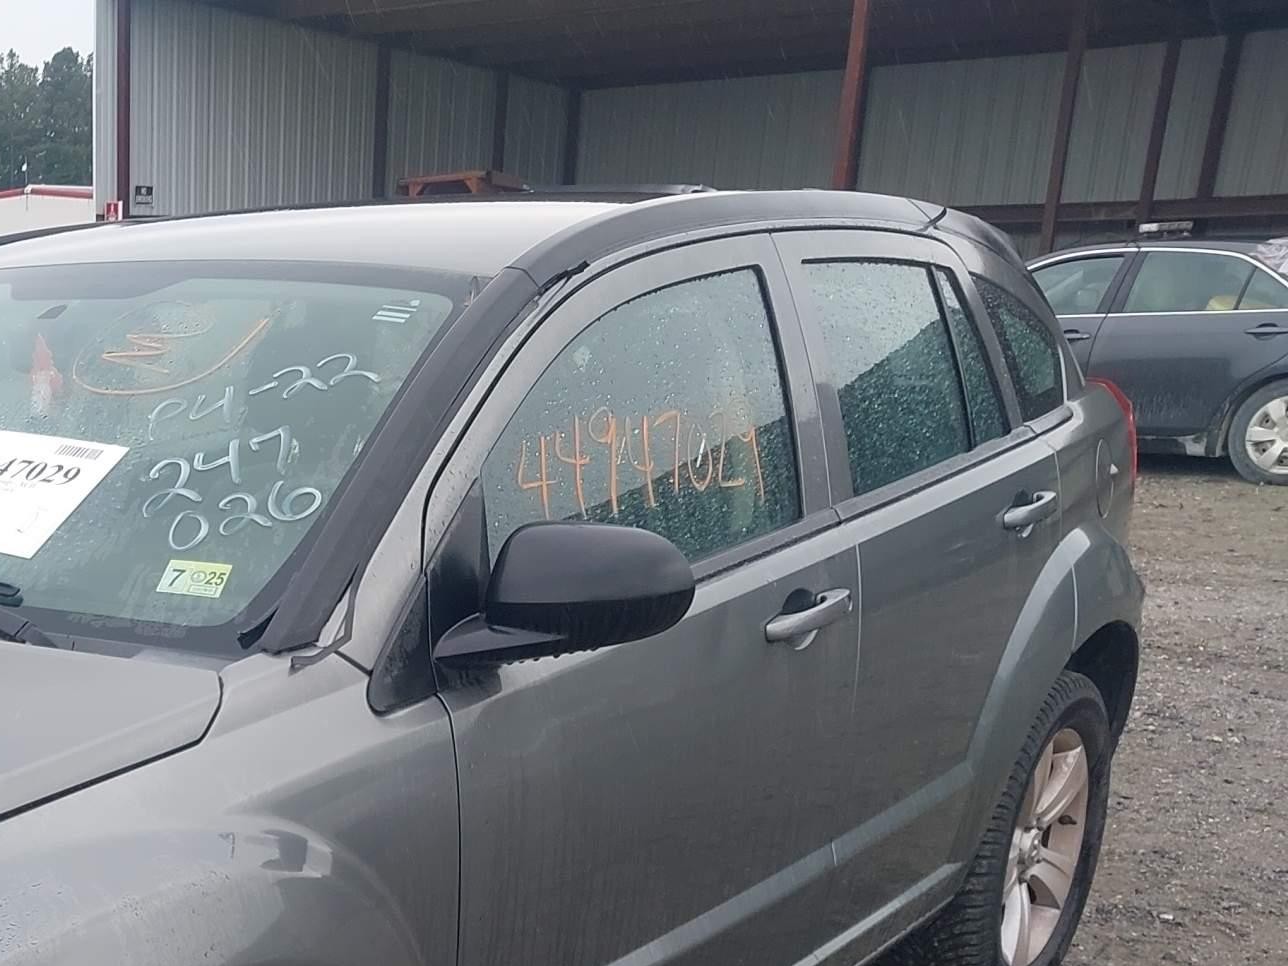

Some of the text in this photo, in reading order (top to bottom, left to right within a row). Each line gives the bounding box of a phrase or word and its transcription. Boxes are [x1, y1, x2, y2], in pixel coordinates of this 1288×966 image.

[143, 425, 290, 518] 247
[169, 480, 322, 550] 026
[168, 568, 227, 587] 7 25
